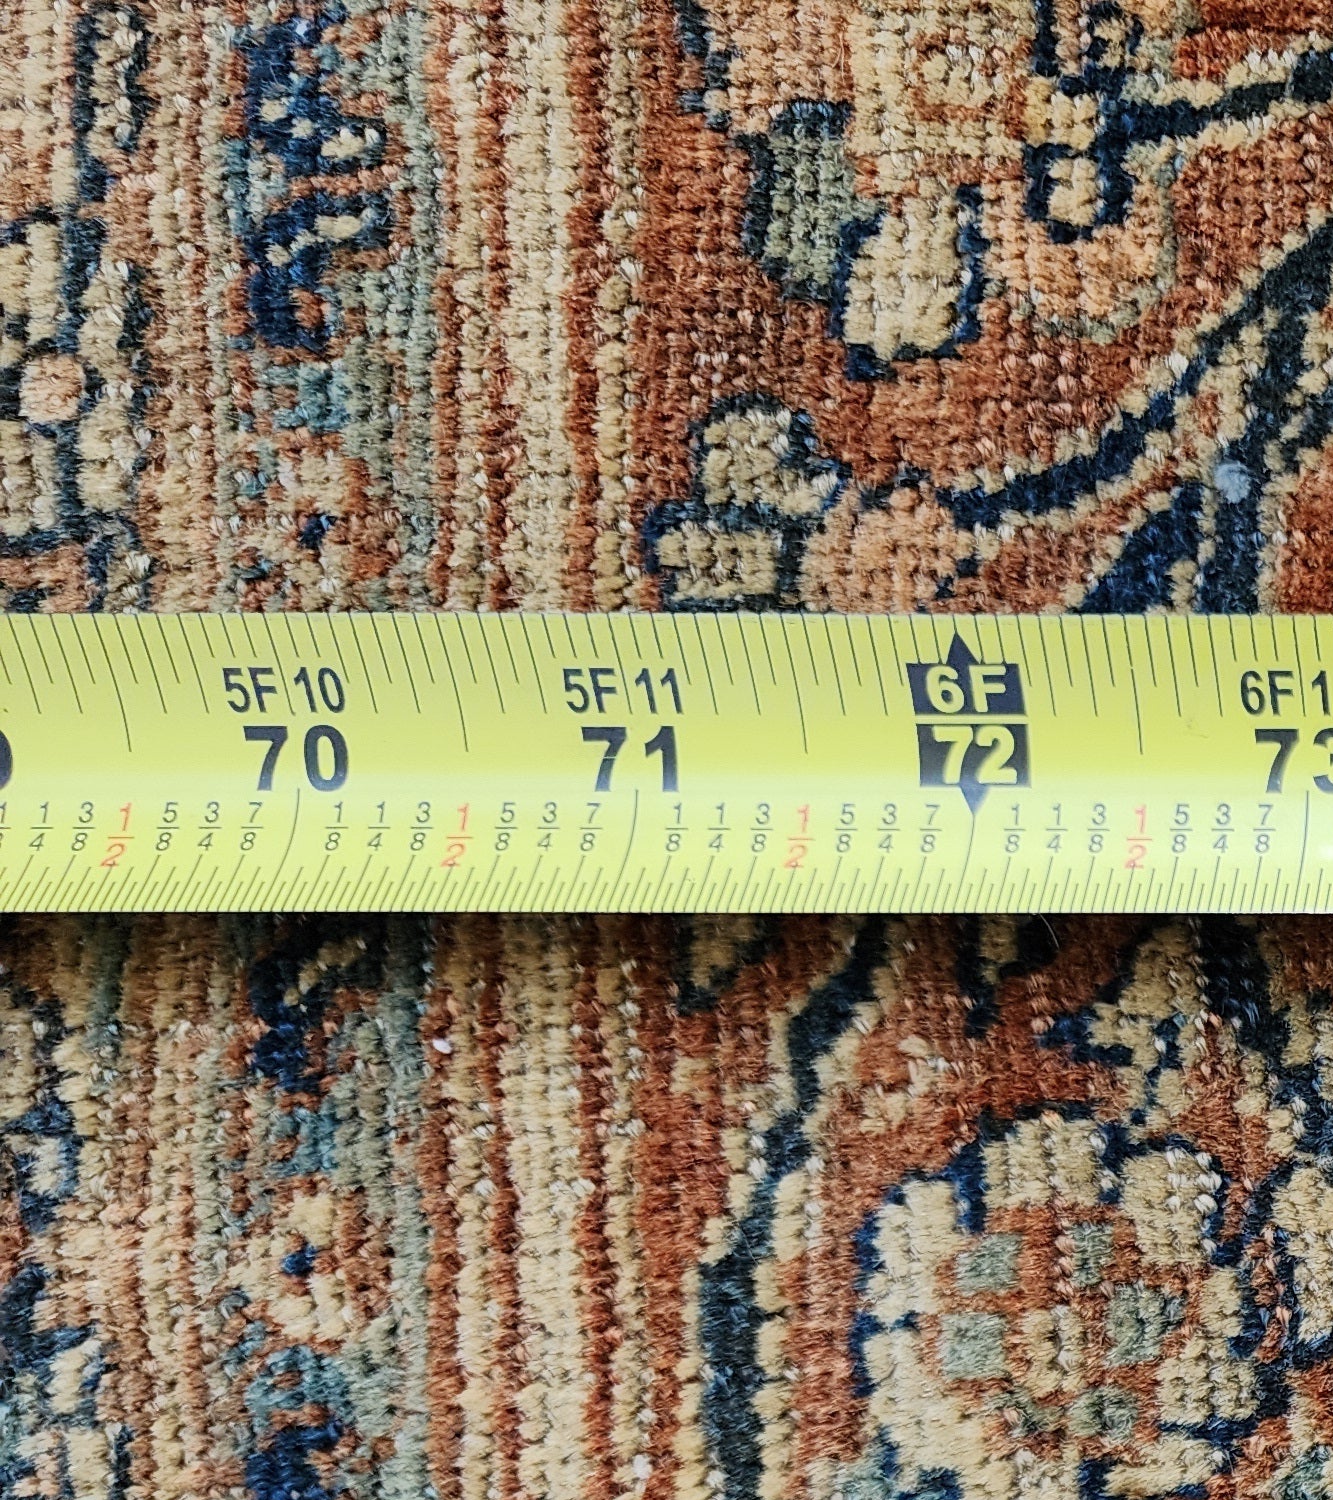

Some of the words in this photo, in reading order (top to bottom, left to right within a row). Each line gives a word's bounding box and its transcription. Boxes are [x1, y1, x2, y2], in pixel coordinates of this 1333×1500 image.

[924, 666, 1008, 712] 6F
[242, 726, 349, 792] 70
[580, 726, 680, 792] 71
[932, 726, 1019, 786] 72
